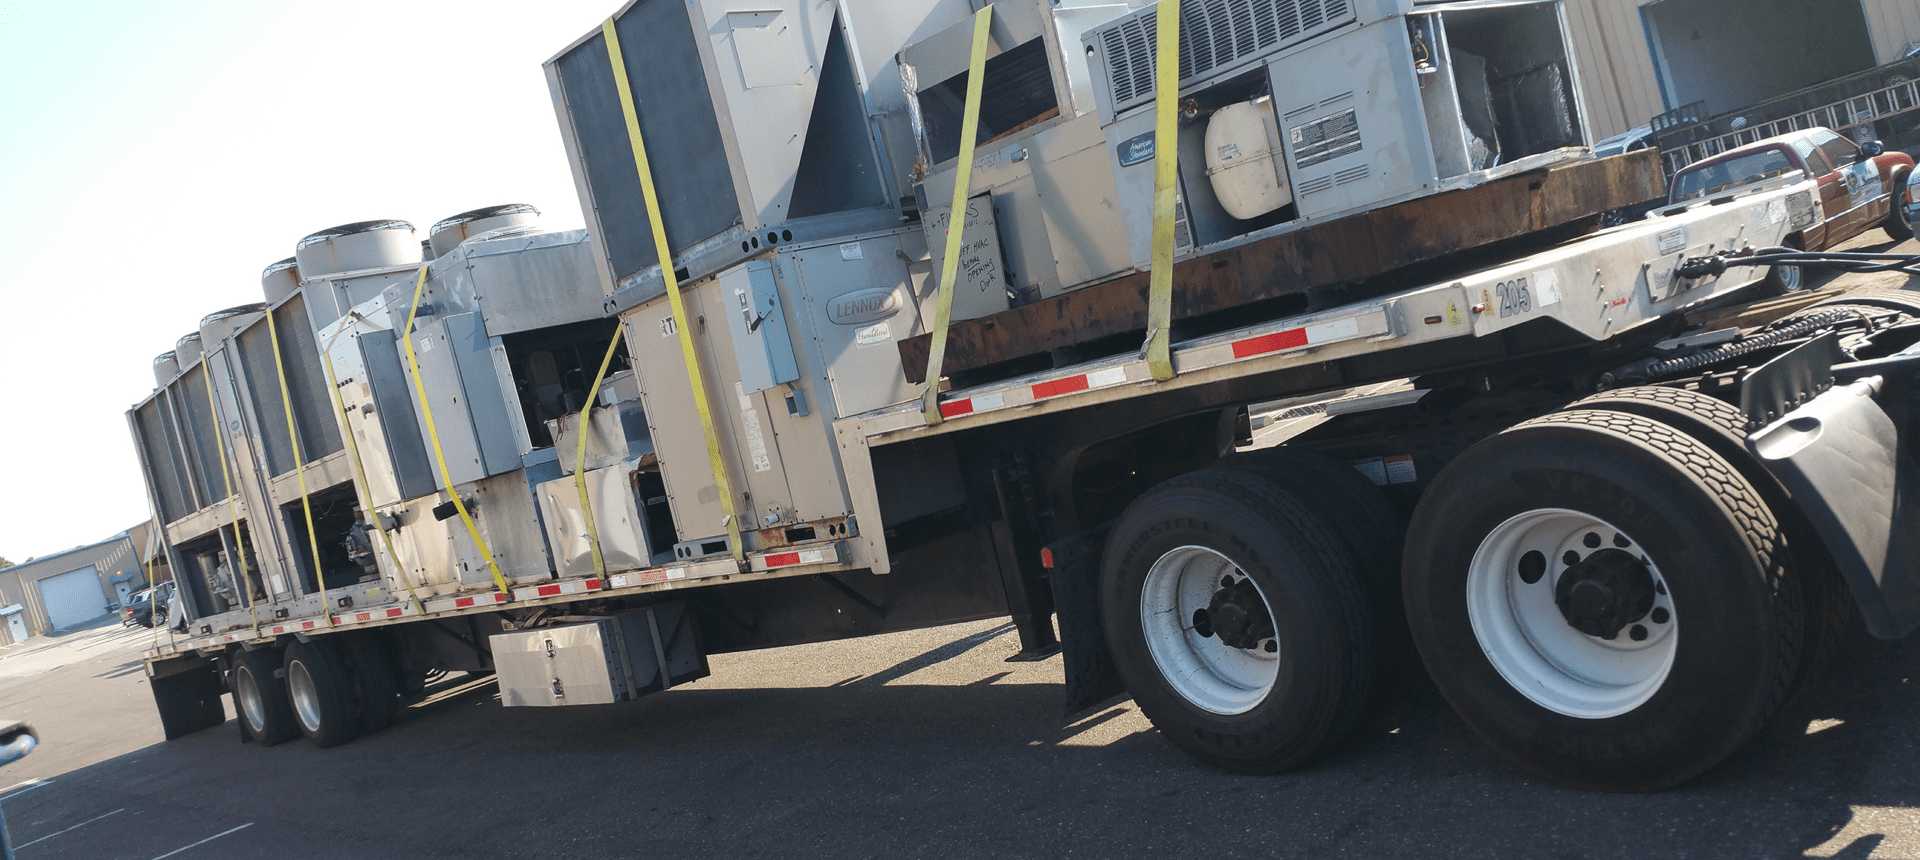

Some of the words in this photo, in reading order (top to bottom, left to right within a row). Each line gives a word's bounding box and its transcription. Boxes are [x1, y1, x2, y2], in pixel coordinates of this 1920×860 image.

[973, 238, 989, 252] HVAC
[836, 295, 885, 318] LENNOX
[1495, 277, 1531, 318] 205
